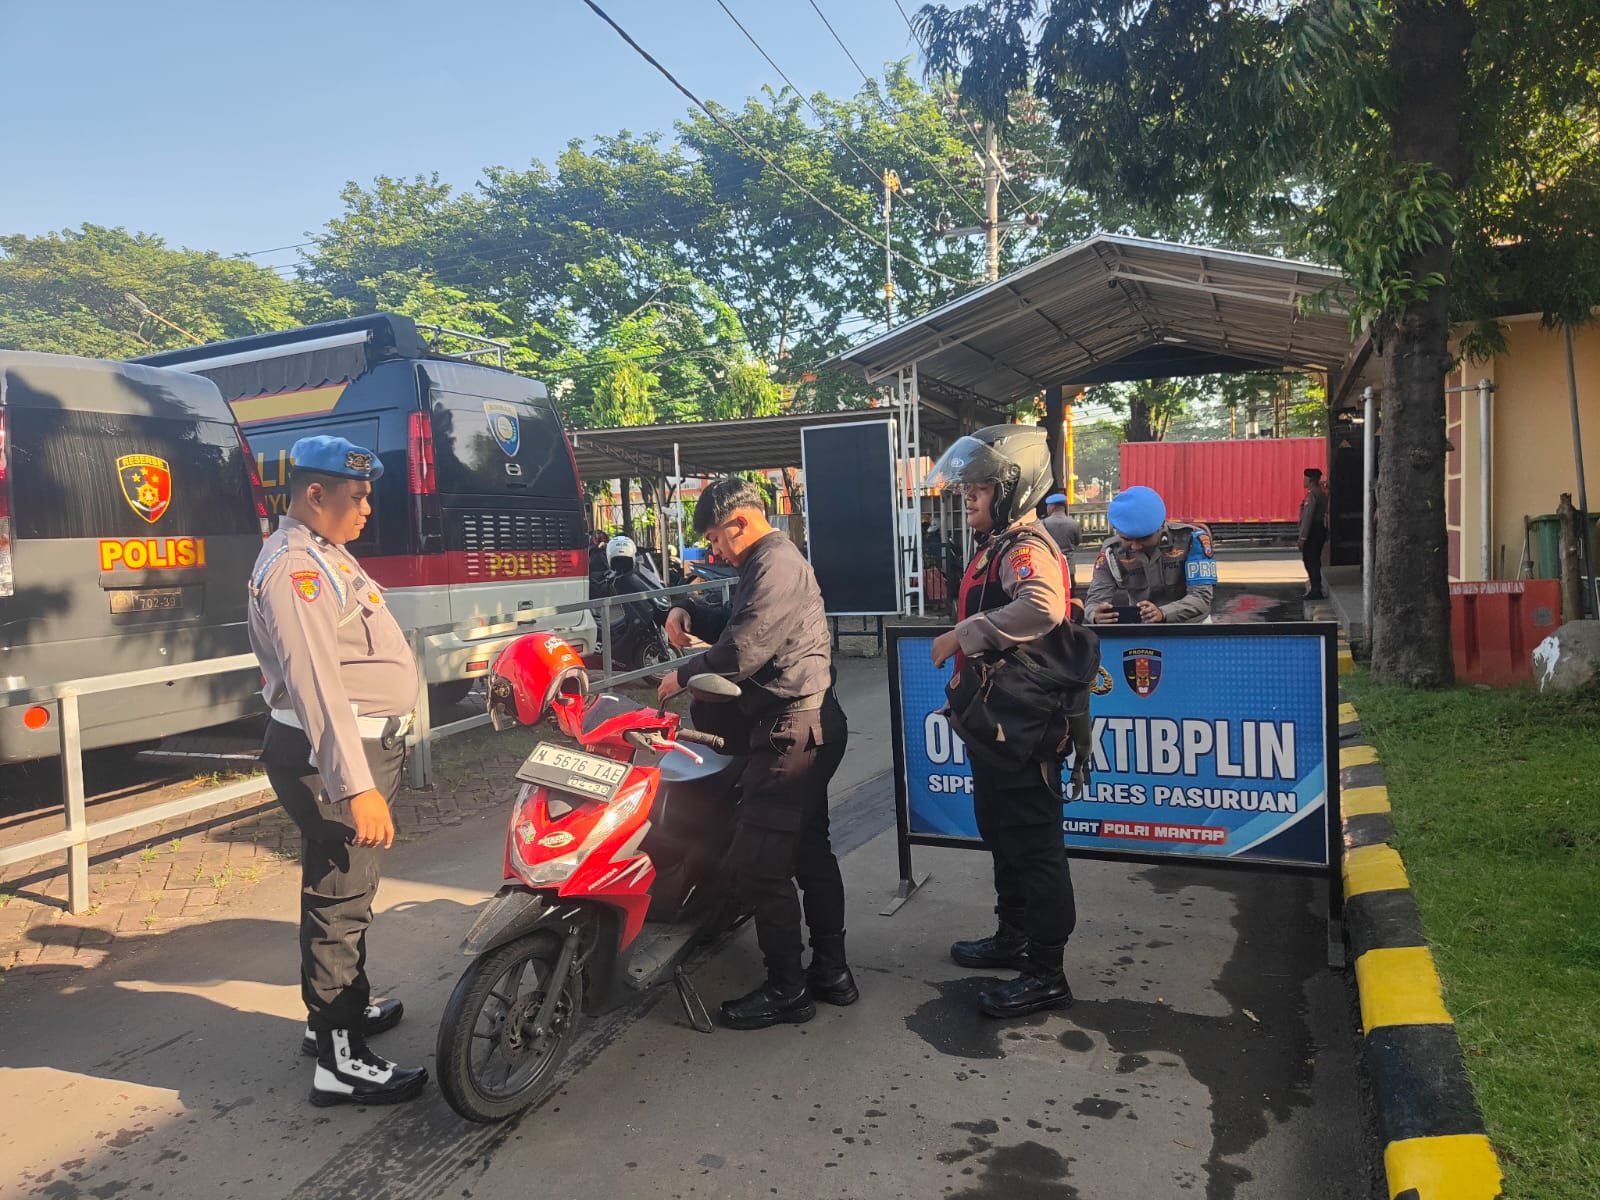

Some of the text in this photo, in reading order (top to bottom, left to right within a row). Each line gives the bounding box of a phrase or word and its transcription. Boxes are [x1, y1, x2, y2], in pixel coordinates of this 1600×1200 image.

[100, 538, 206, 570] POLISI
[489, 553, 557, 577] POLISI
[1480, 582, 1526, 594] PASURUAN
[537, 749, 622, 782] N 5676 TAE
[1154, 786, 1297, 813] PASURUAN
[1103, 822, 1149, 837] POLRI
[1154, 827, 1225, 842] MANTAP
[587, 867, 619, 892] HONDA
